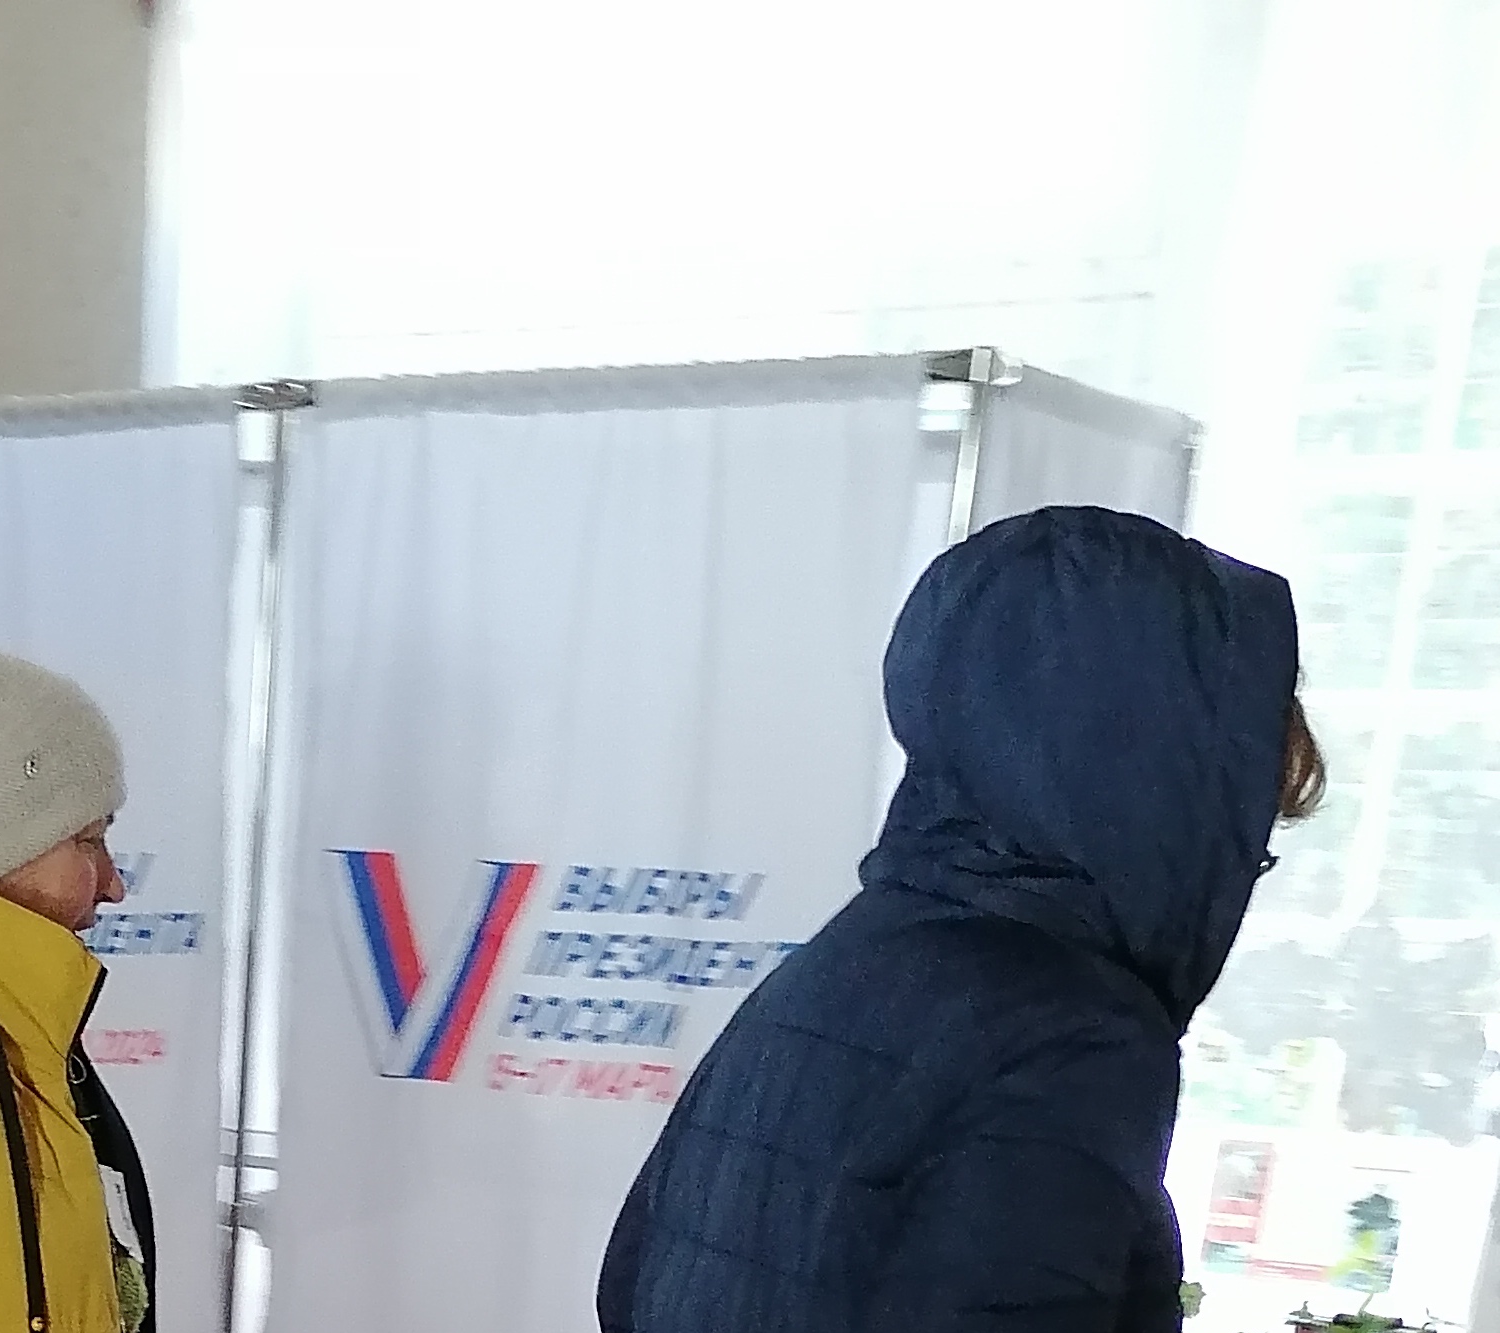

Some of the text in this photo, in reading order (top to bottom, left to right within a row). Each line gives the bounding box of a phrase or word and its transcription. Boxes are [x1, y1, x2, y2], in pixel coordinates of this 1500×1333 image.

[552, 864, 766, 922] ВЫБОРЫ
[85, 911, 205, 956] ДЕНТА
[522, 931, 808, 990] ПРЕЗИДЕН
[497, 993, 687, 1048] РОССИИ
